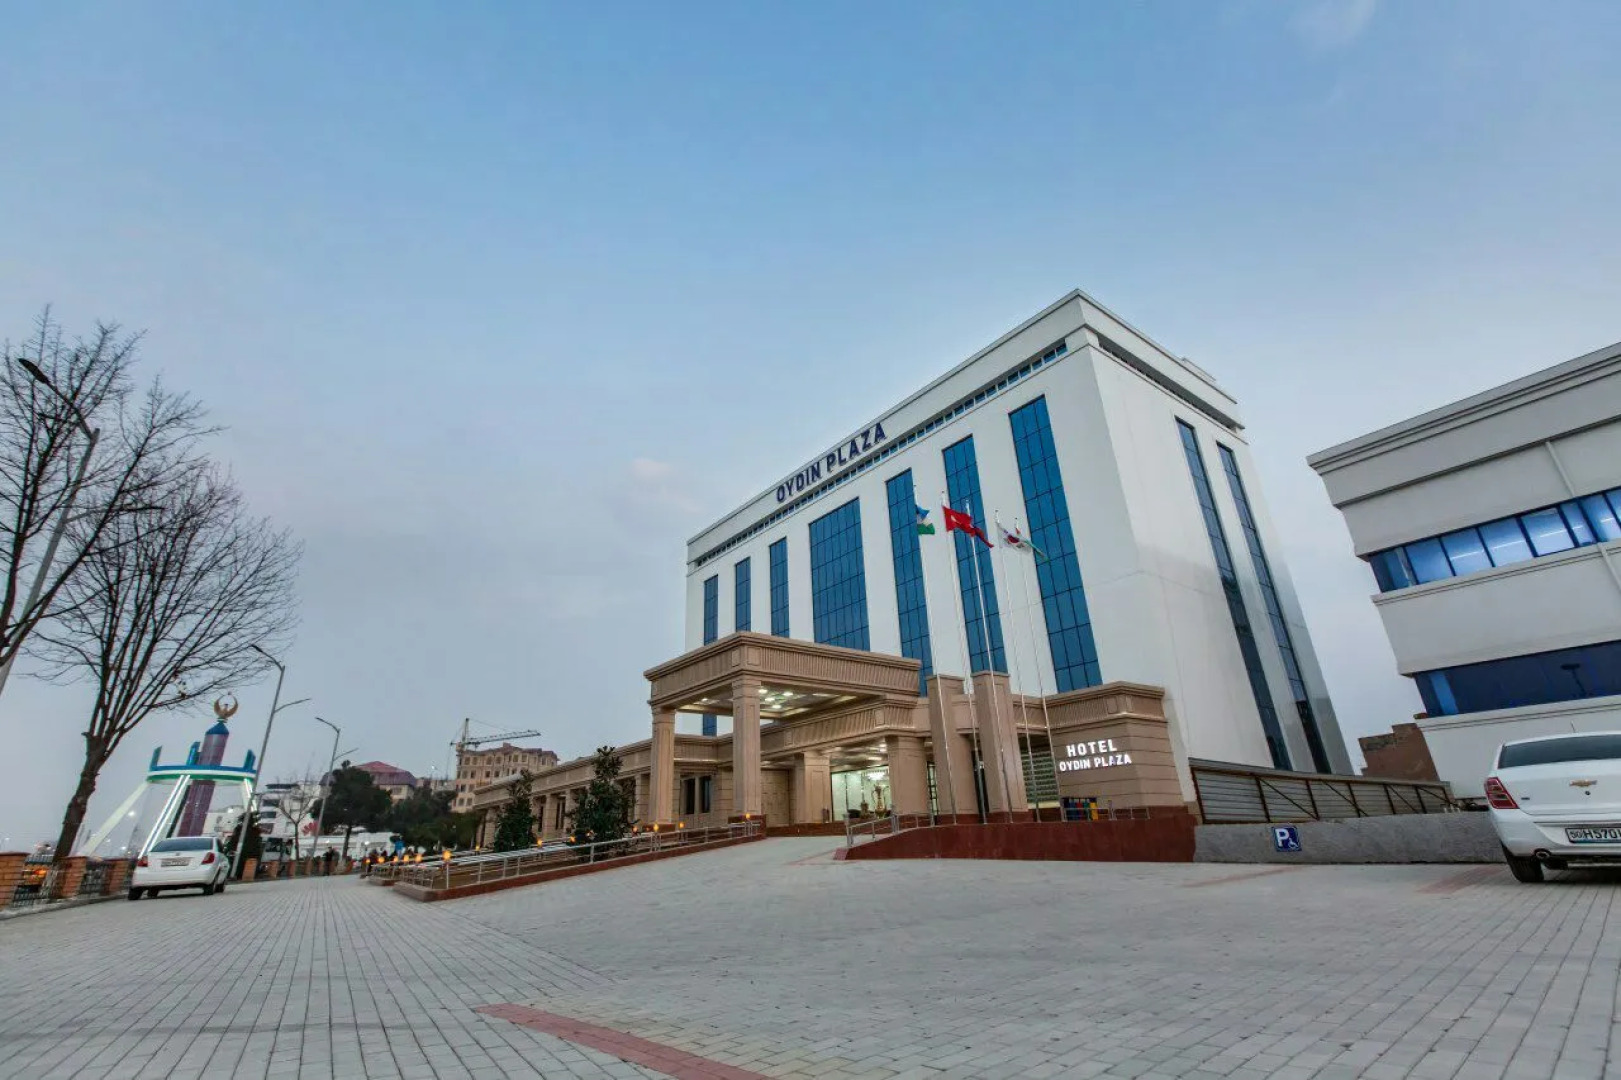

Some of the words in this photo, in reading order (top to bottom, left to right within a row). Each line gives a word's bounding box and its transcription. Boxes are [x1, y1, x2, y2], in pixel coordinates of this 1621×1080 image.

[777, 461, 821, 502] OYDIN
[826, 422, 886, 472] PLAZA
[1066, 739, 1117, 757] HOTEL
[1059, 758, 1090, 772] OYDIN
[1094, 753, 1132, 768] PLAZA
[1275, 828, 1290, 847] P
